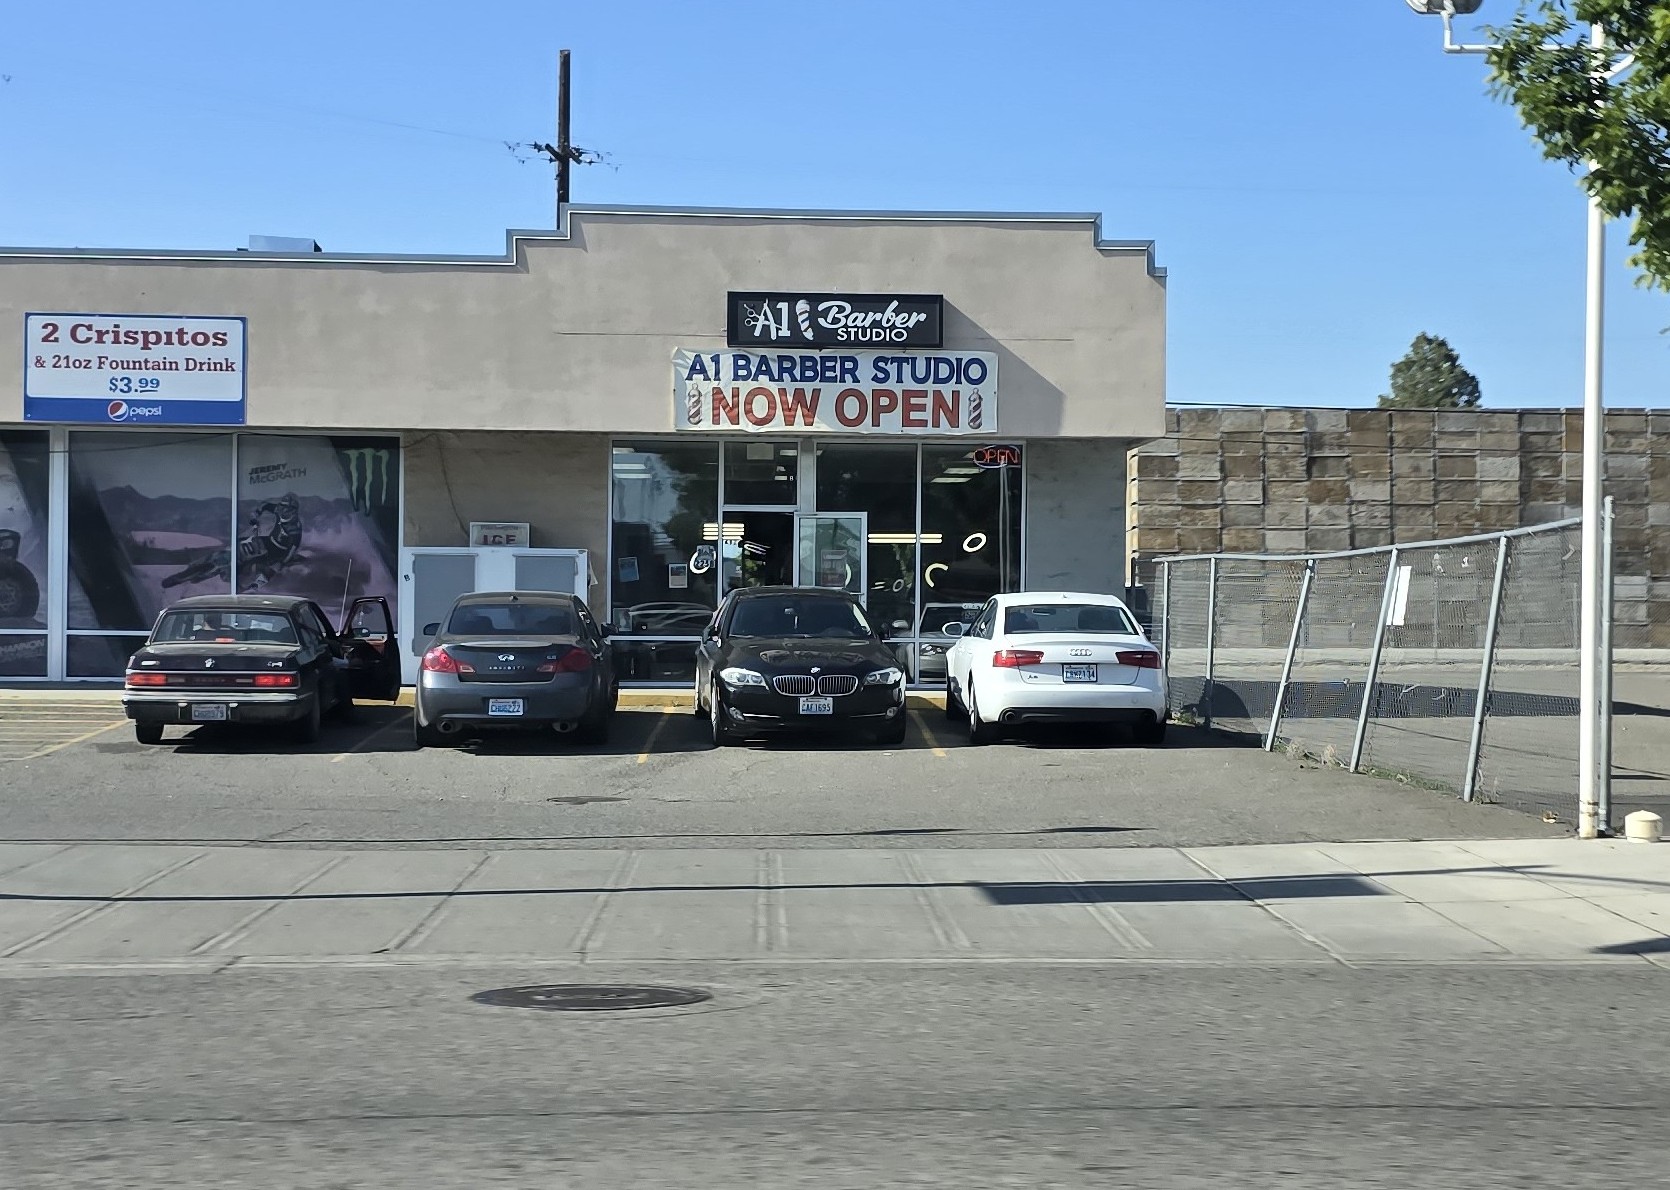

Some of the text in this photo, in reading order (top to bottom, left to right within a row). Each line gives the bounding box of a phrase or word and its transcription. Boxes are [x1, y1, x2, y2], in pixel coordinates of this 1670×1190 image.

[753, 298, 927, 340] A1 Barber
[41, 322, 59, 343] 2
[836, 328, 909, 342] STUDIO
[34, 354, 236, 372] & 21oz Fountain Drink
[685, 353, 988, 385] A1 BARBER STUDIO
[109, 375, 160, 394] $3.99
[129, 406, 162, 418] pepsi
[711, 386, 961, 429] NOW OPEN
[973, 448, 1019, 464] OPEN
[248, 462, 288, 475] JEREMY
[249, 467, 307, 485] McGRATH
[483, 534, 517, 545] ICE
